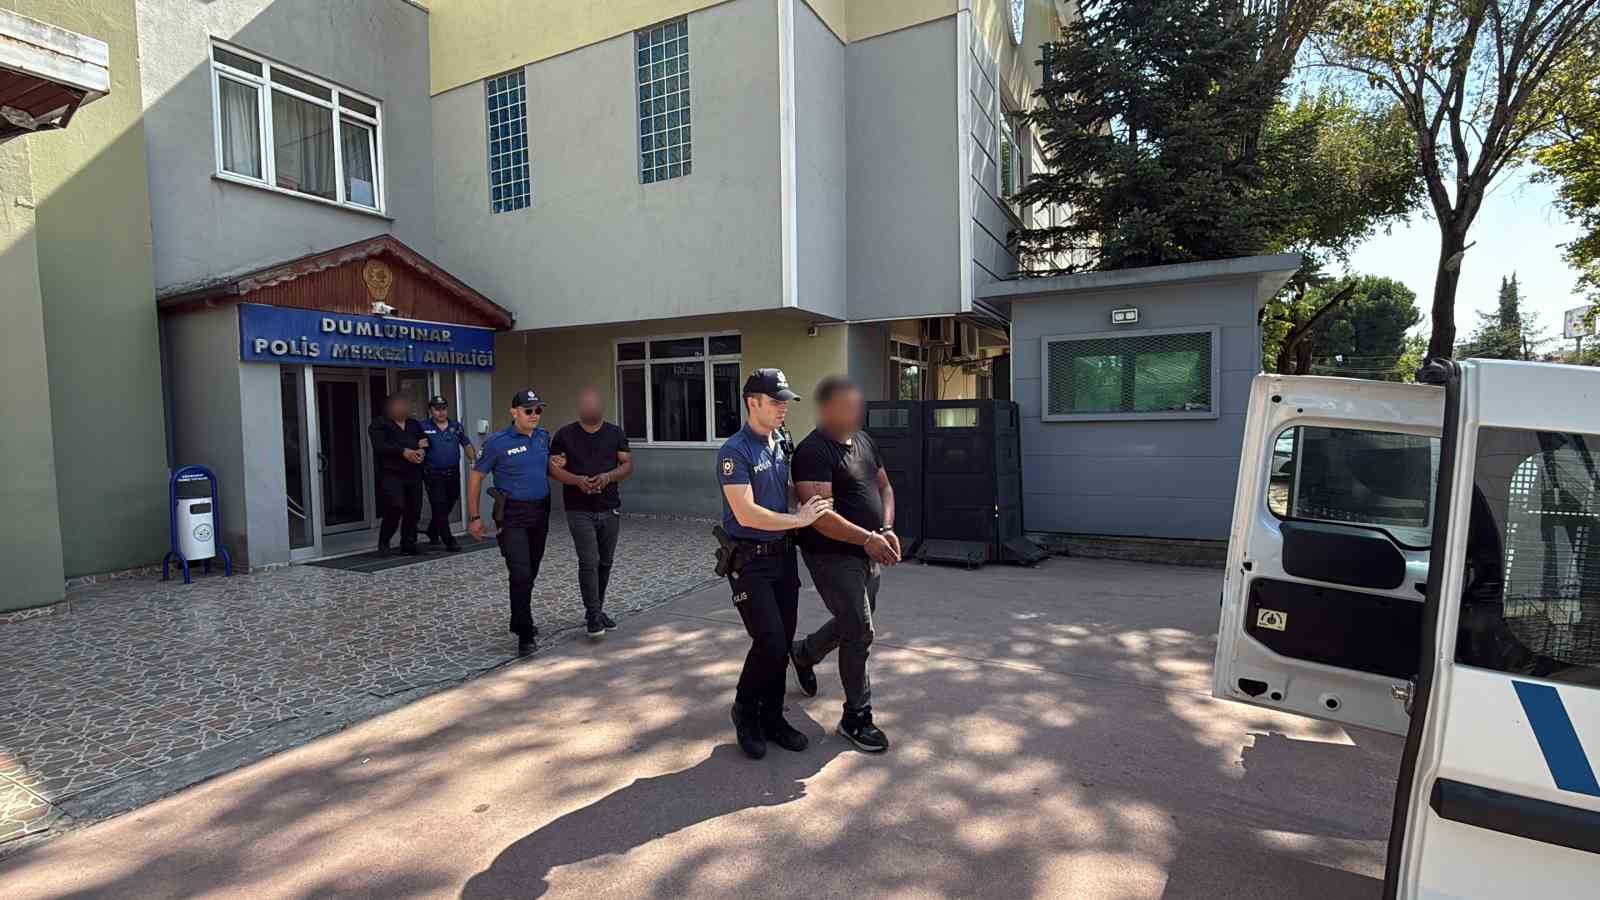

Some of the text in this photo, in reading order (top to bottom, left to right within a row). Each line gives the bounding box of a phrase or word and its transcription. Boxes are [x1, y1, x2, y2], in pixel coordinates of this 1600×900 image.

[321, 317, 452, 343] DUMLUPINAR
[254, 335, 494, 368] POLİS MERKEZİ AMİRLİĞİ
